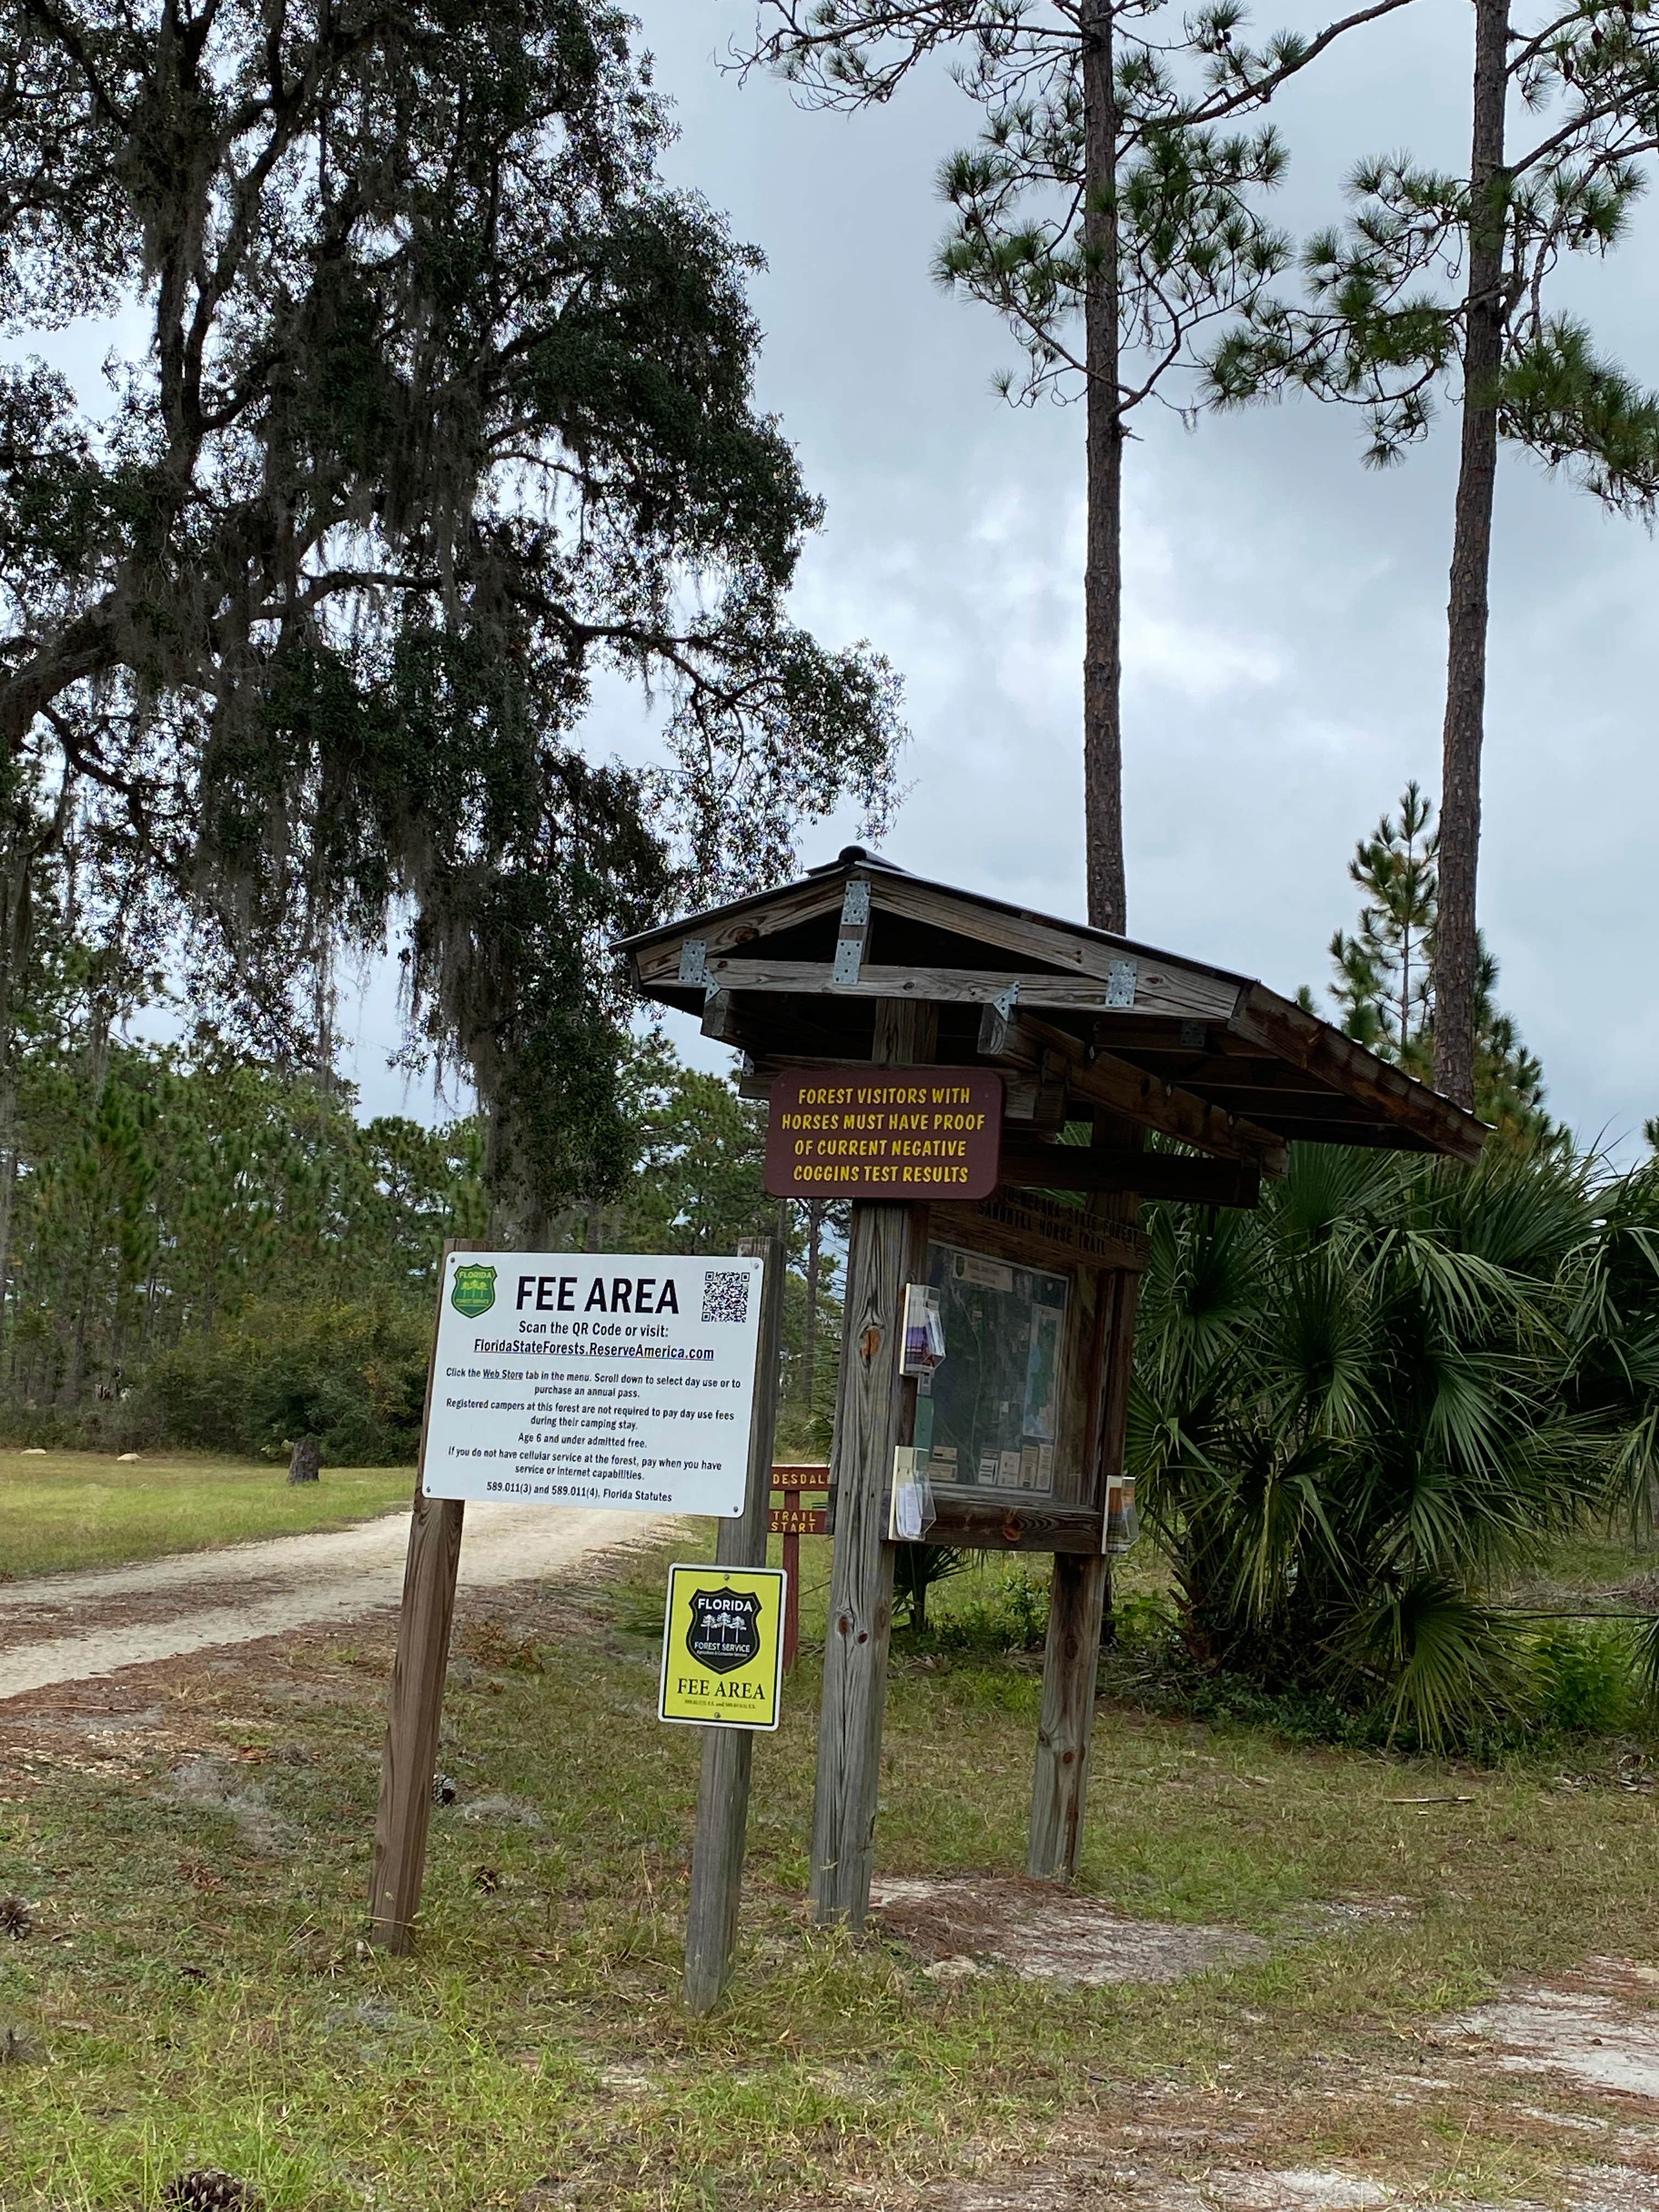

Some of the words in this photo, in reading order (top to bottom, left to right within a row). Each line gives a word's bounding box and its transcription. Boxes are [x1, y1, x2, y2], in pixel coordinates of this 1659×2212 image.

[799, 1088, 854, 1104] FOREST
[857, 1087, 927, 1104] VISITORS
[932, 1087, 970, 1104] WITH
[782, 1113, 839, 1130] HORSES
[843, 1113, 884, 1130] MUST
[889, 1113, 929, 1130] HAVE
[934, 1114, 985, 1130] PROOF
[794, 1139, 814, 1155] OF
[817, 1139, 888, 1156] CURRENT
[891, 1139, 967, 1156] NEGATIVE
[793, 1165, 860, 1182] COGGINS
[864, 1165, 899, 1182] TEST
[902, 1166, 969, 1183] RESULTS
[1068, 1207, 1098, 1231] STATE
[1105, 1219, 1138, 1246] FOREST
[1040, 1218, 1073, 1245] HORSE
[1079, 1232, 1107, 1256] TRAIL
[516, 1276, 578, 1311] FEE
[584, 1278, 679, 1314] AREA
[519, 1321, 547, 1334] Scan
[550, 1322, 569, 1335] the
[572, 1322, 589, 1335] QR
[592, 1323, 622, 1336] Code
[625, 1327, 638, 1336] or
[640, 1324, 669, 1338] visit:
[473, 1339, 714, 1361] FloridaStateForests.ReserveAmerica.com
[446, 1368, 466, 1378] Click
[468, 1369, 481, 1378] the
[483, 1369, 500, 1379] Web
[502, 1369, 523, 1380] Store
[526, 1370, 539, 1380] tab
[541, 1371, 549, 1380] in
[551, 1372, 565, 1381] the
[567, 1374, 592, 1383] menu.
[595, 1373, 619, 1383] Scroll
[621, 1374, 643, 1384] down
[645, 1375, 654, 1385] to
[657, 1376, 683, 1386] select
[685, 1377, 700, 1388] day
[732, 1379, 741, 1388] to
[534, 1385, 572, 1396] purchase
[587, 1388, 616, 1397] annual
[618, 1390, 640, 1399] pass.
[447, 1398, 489, 1409] Registered
[490, 1402, 524, 1412] campers
[527, 1403, 535, 1411] at
[538, 1402, 552, 1412] this
[555, 1403, 580, 1413] forest
[597, 1405, 612, 1414] not
[614, 1406, 650, 1417] required
[652, 1407, 661, 1417] to
[663, 1409, 678, 1419] pay
[680, 1408, 695, 1420] day
[715, 1409, 735, 1420] fees
[531, 1415, 557, 1427] during
[559, 1417, 579, 1426] their
[580, 1419, 617, 1430] camping
[618, 1420, 638, 1431] stay.
[518, 1432, 534, 1443] Age
[537, 1433, 541, 1442] 6
[544, 1434, 559, 1443] and
[561, 1435, 585, 1444] under
[588, 1436, 625, 1447] admitted
[628, 1437, 647, 1448] free.
[448, 1446, 455, 1455] If
[456, 1448, 470, 1457] you
[472, 1448, 481, 1457] do
[483, 1449, 497, 1457] not
[499, 1449, 517, 1458] have
[519, 1451, 550, 1460] cellular
[552, 1453, 582, 1462] service
[584, 1454, 593, 1463] at
[595, 1454, 609, 1464] the
[611, 1454, 639, 1466] forest,
[641, 1458, 657, 1468] pay
[659, 1458, 681, 1468] when
[684, 1462, 699, 1470] you
[701, 1460, 722, 1470] have
[515, 1464, 545, 1474] service
[557, 1466, 590, 1477] internet
[592, 1469, 645, 1480] capabilities.
[487, 1482, 532, 1494] 589.011(3)
[534, 1485, 549, 1494] and
[603, 1489, 632, 1500] Florida
[635, 1491, 672, 1502] Statutes
[774, 1511, 816, 1522] TRAIL
[771, 1521, 816, 1532] START
[698, 1598, 753, 1612] FLORIDA
[694, 1641, 721, 1651] FOREST
[721, 1643, 751, 1653] SERVICE
[677, 1678, 710, 1696] FEE
[714, 1680, 765, 1700] AREA
